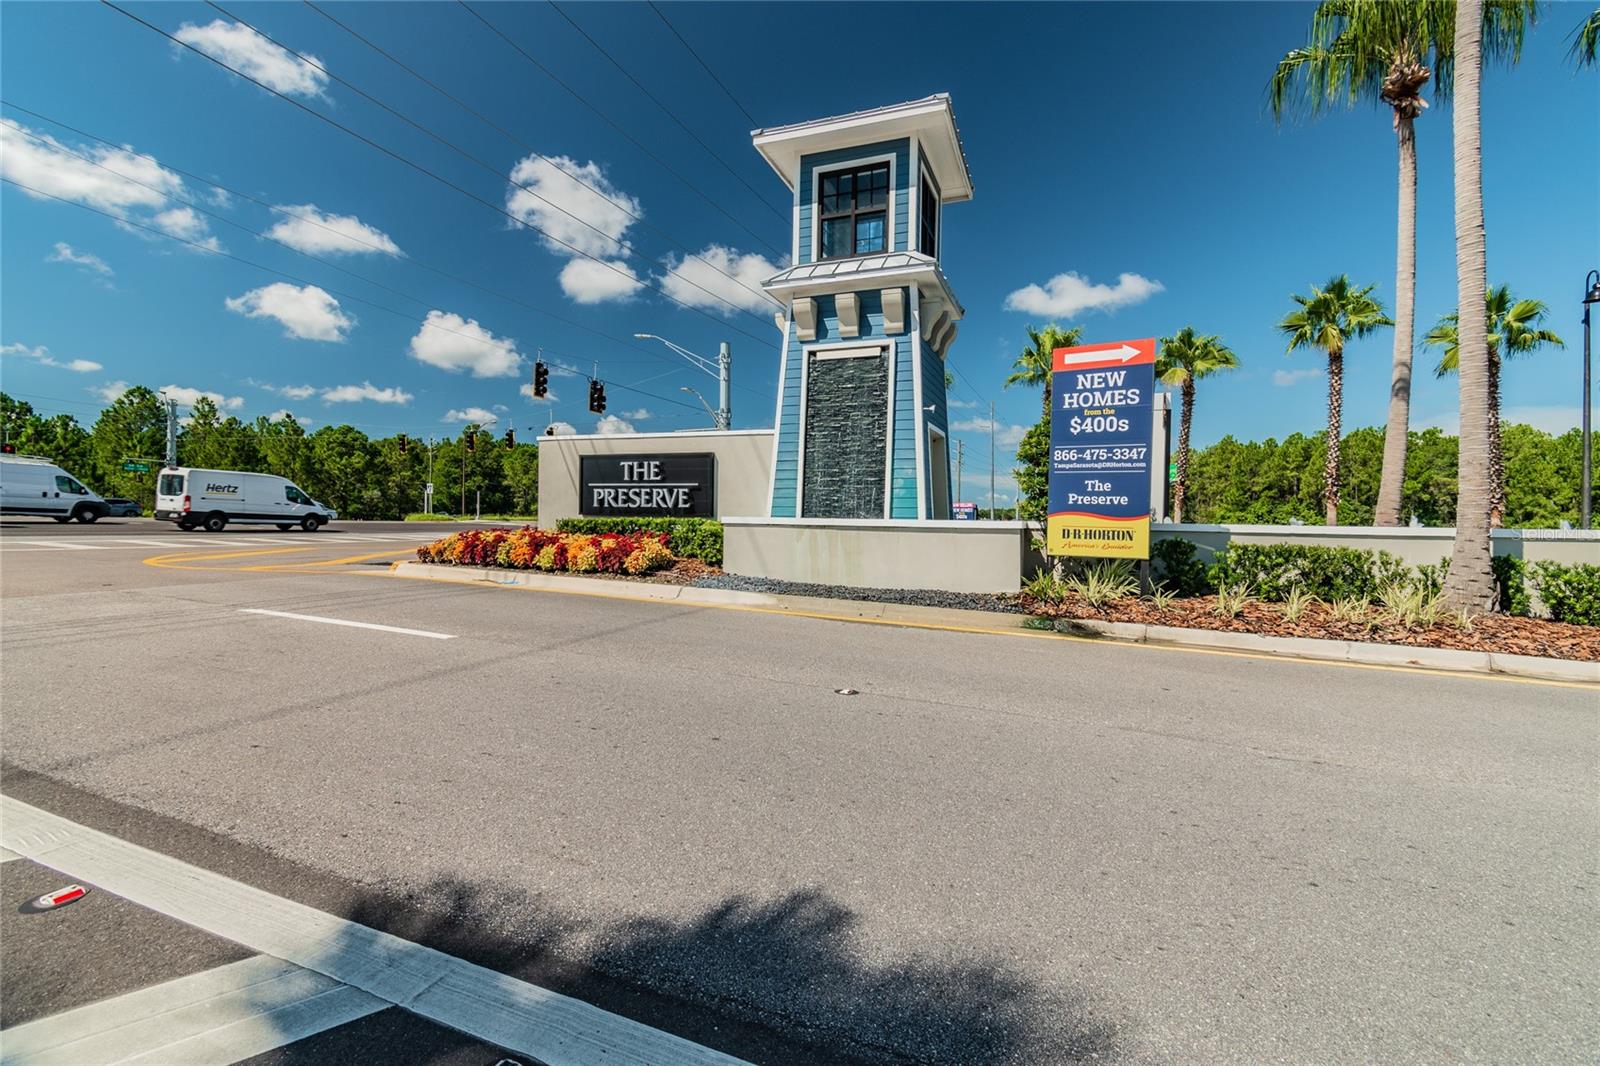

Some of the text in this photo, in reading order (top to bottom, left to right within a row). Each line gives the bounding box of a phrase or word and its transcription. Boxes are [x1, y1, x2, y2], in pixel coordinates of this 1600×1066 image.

[1076, 371, 1126, 389] NEW
[1063, 389, 1140, 408] HOMES
[1084, 407, 1116, 416] from the
[1070, 416, 1129, 435] $400s
[1053, 447, 1147, 461] 866-475-3347
[620, 461, 661, 481] THE
[206, 483, 239, 493] Hertz
[1084, 479, 1112, 492] The
[592, 488, 691, 508] PRESERVE
[1067, 493, 1129, 505] Preserve
